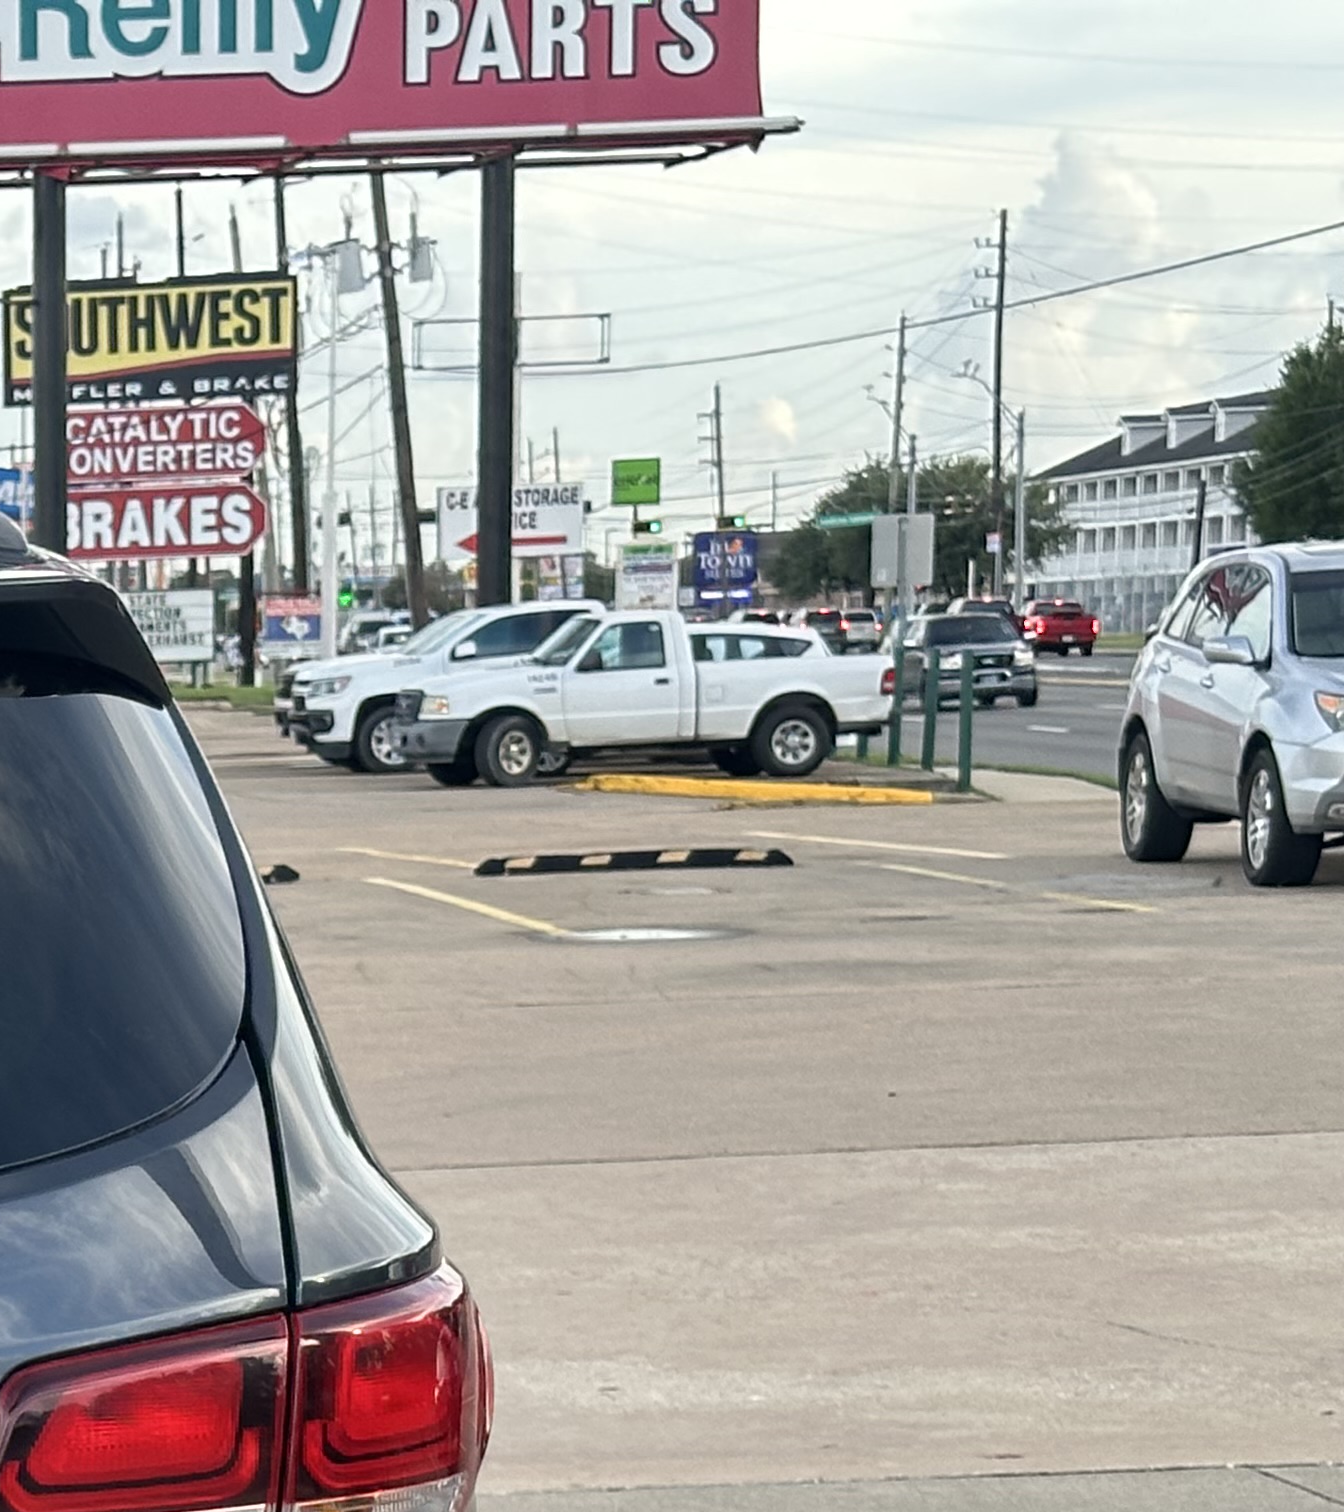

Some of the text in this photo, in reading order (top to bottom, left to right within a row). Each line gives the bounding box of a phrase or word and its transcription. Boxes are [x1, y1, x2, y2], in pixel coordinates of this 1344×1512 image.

[404, 0, 715, 84] PARTS
[14, 287, 289, 360] SUTHWEST
[13, 374, 289, 401] MFLER & BRAKE
[66, 409, 242, 444] CATALYTIC
[69, 441, 255, 475] ONVERTERS
[514, 486, 579, 508] STORAGE
